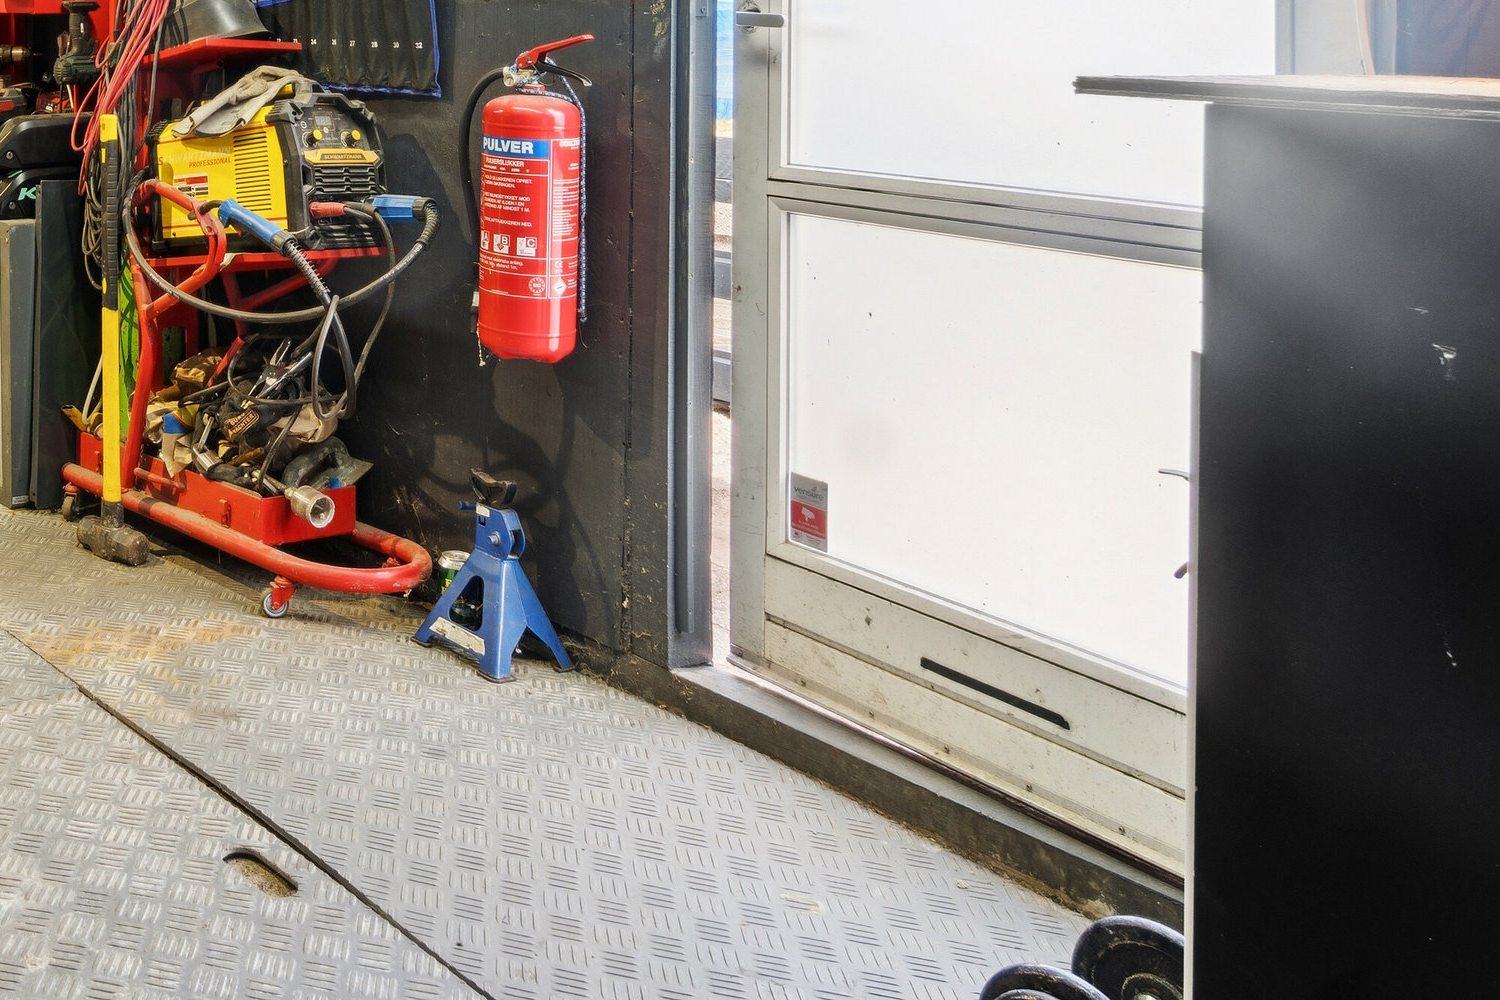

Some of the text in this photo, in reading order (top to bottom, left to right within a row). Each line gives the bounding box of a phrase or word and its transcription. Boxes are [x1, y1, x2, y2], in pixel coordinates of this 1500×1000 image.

[483, 137, 534, 155] PULVER
[189, 157, 232, 168] PROFESSIONAL
[18, 187, 36, 200] K
